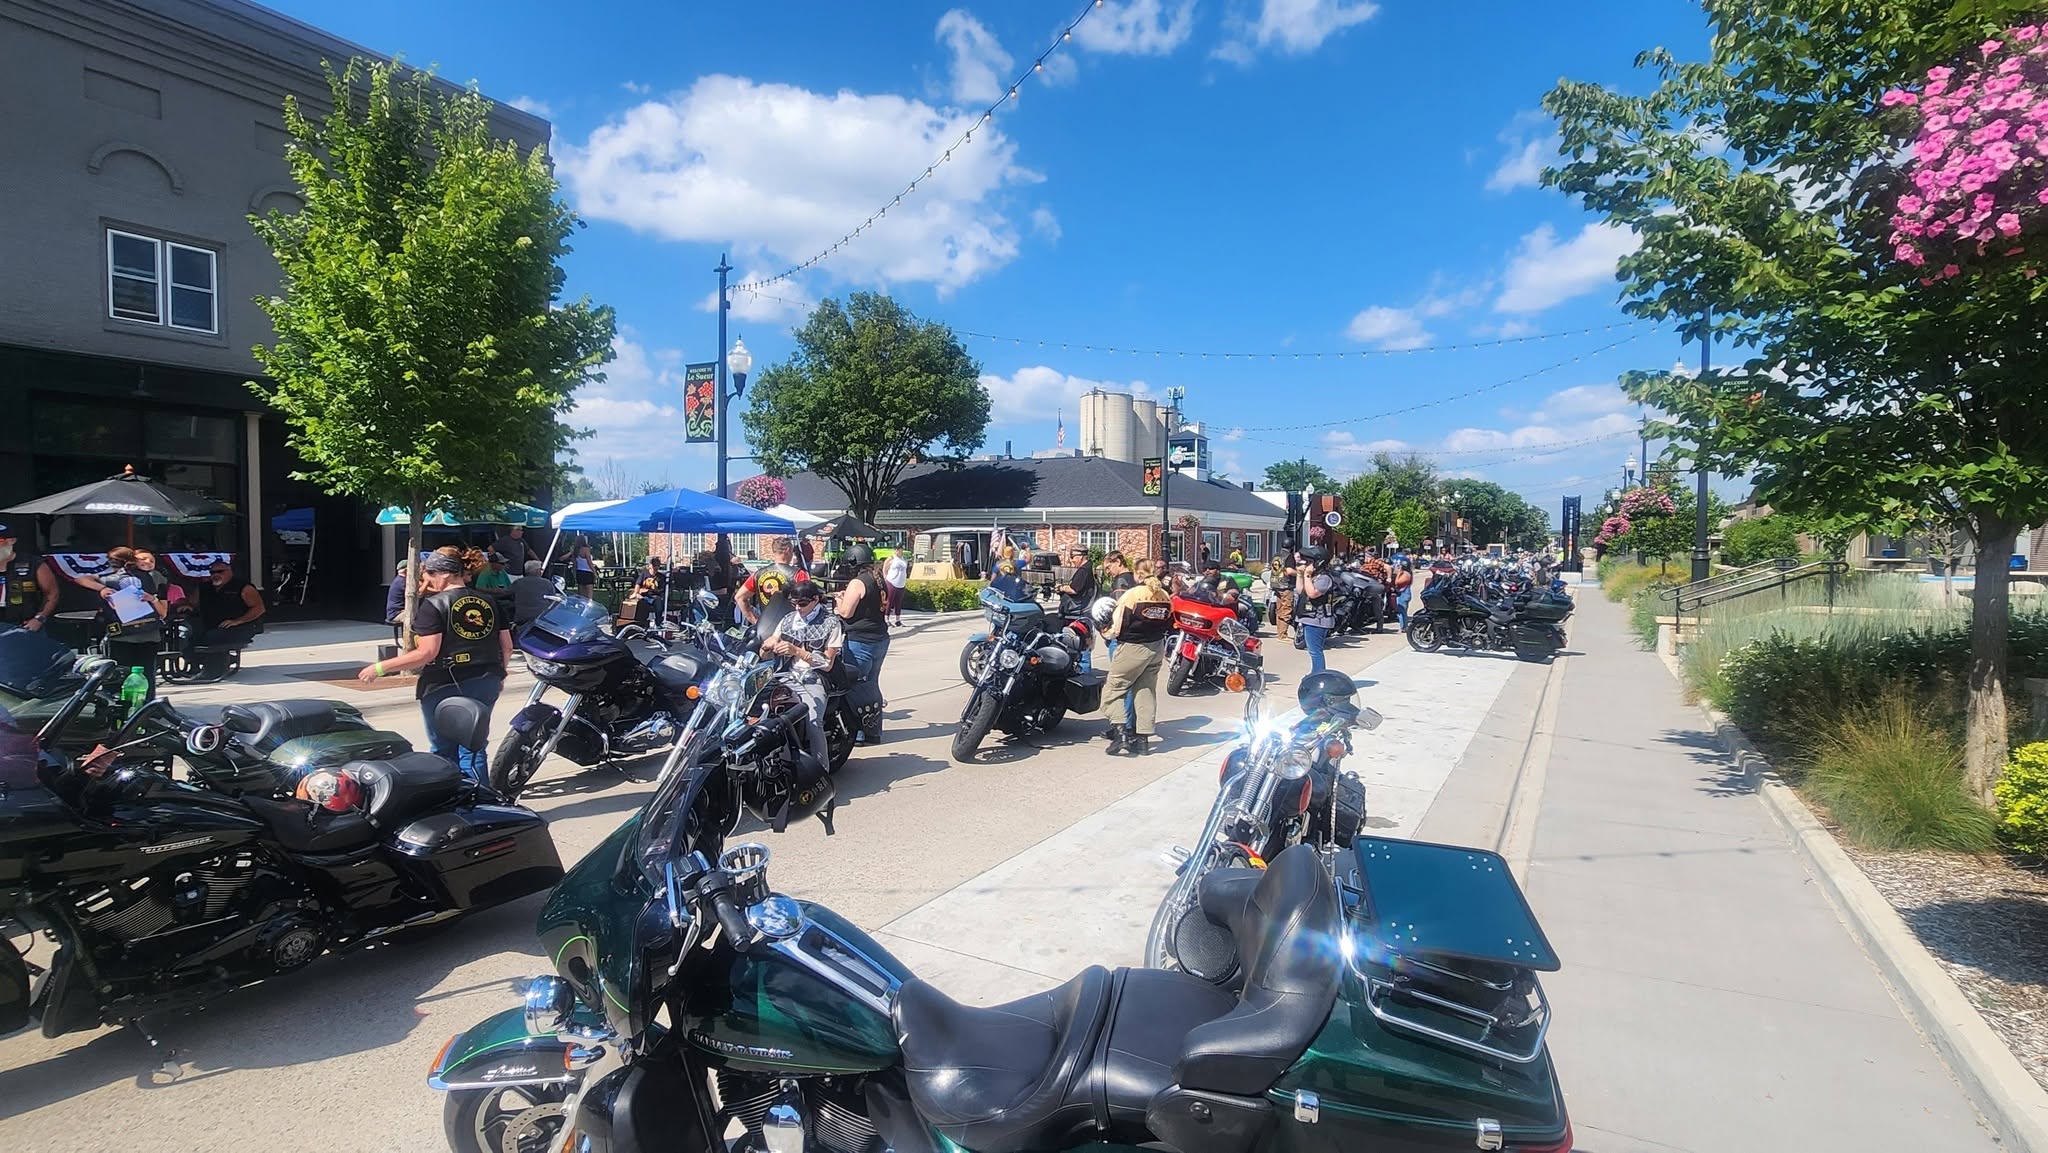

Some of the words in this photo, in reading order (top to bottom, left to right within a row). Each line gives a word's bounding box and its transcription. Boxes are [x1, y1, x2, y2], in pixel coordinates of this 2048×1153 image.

[687, 373, 695, 381] Le
[695, 372, 713, 381] Sueur
[453, 599, 491, 612] AUXILIARY
[454, 622, 480, 638] COMBAT
